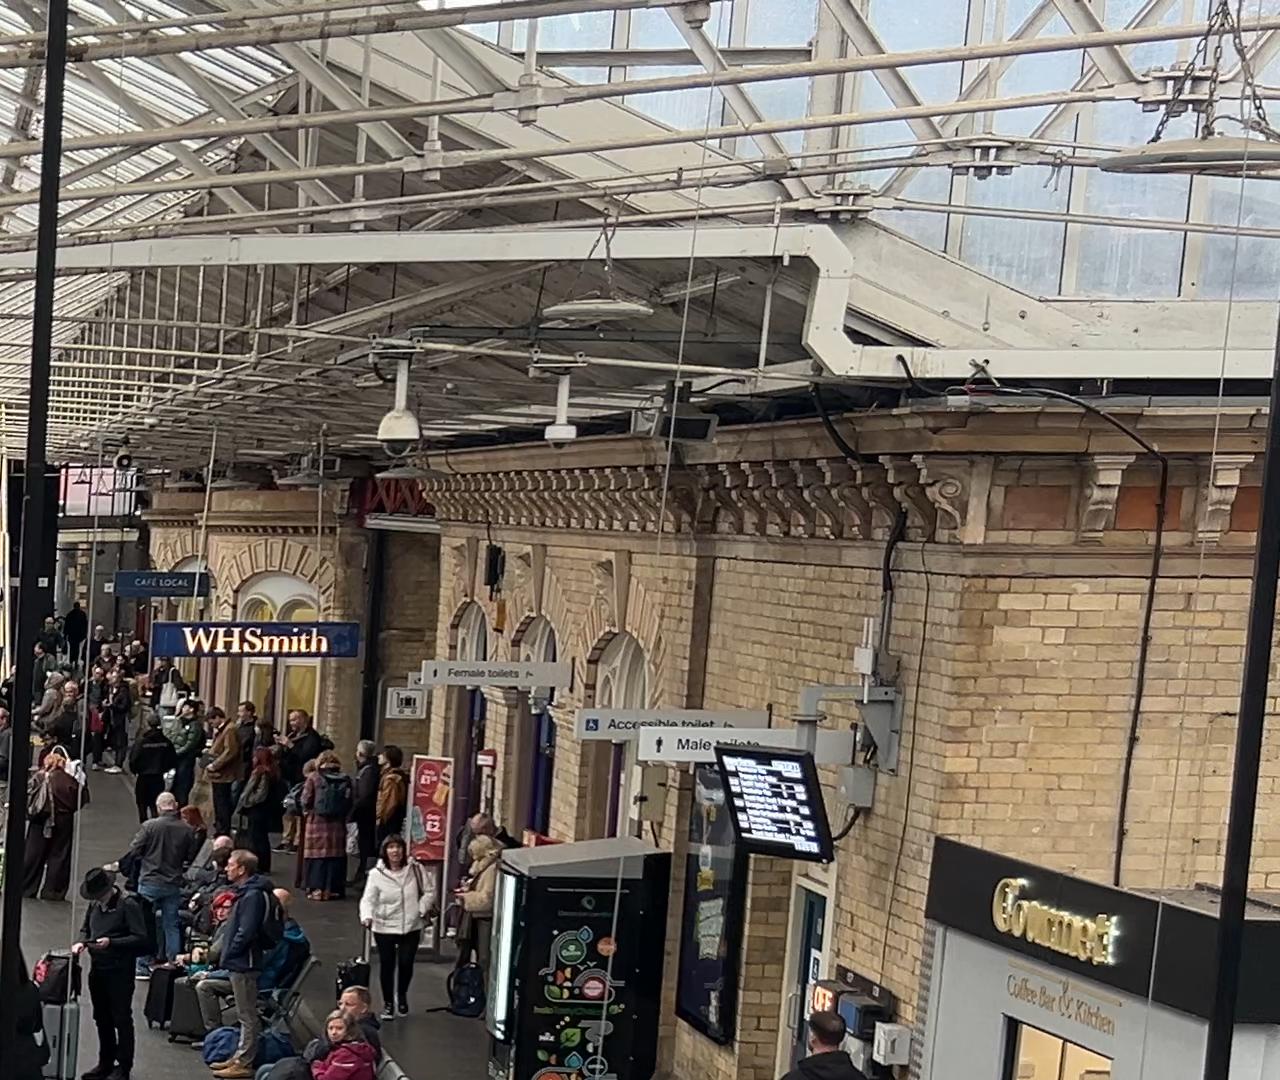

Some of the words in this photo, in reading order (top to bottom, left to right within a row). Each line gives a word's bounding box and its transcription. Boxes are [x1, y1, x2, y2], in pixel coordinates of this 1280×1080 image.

[159, 579, 189, 587] LOCAL
[182, 627, 328, 654] WHSmith
[447, 668, 486, 678] Female
[488, 669, 520, 679] toilets
[676, 738, 712, 752] Male
[992, 877, 1118, 966] Gourmet
[1007, 973, 1038, 1005] Coffee
[1039, 985, 1056, 1012] Bar
[1058, 977, 1074, 1019] &
[1074, 999, 1115, 1037] Kitchen
